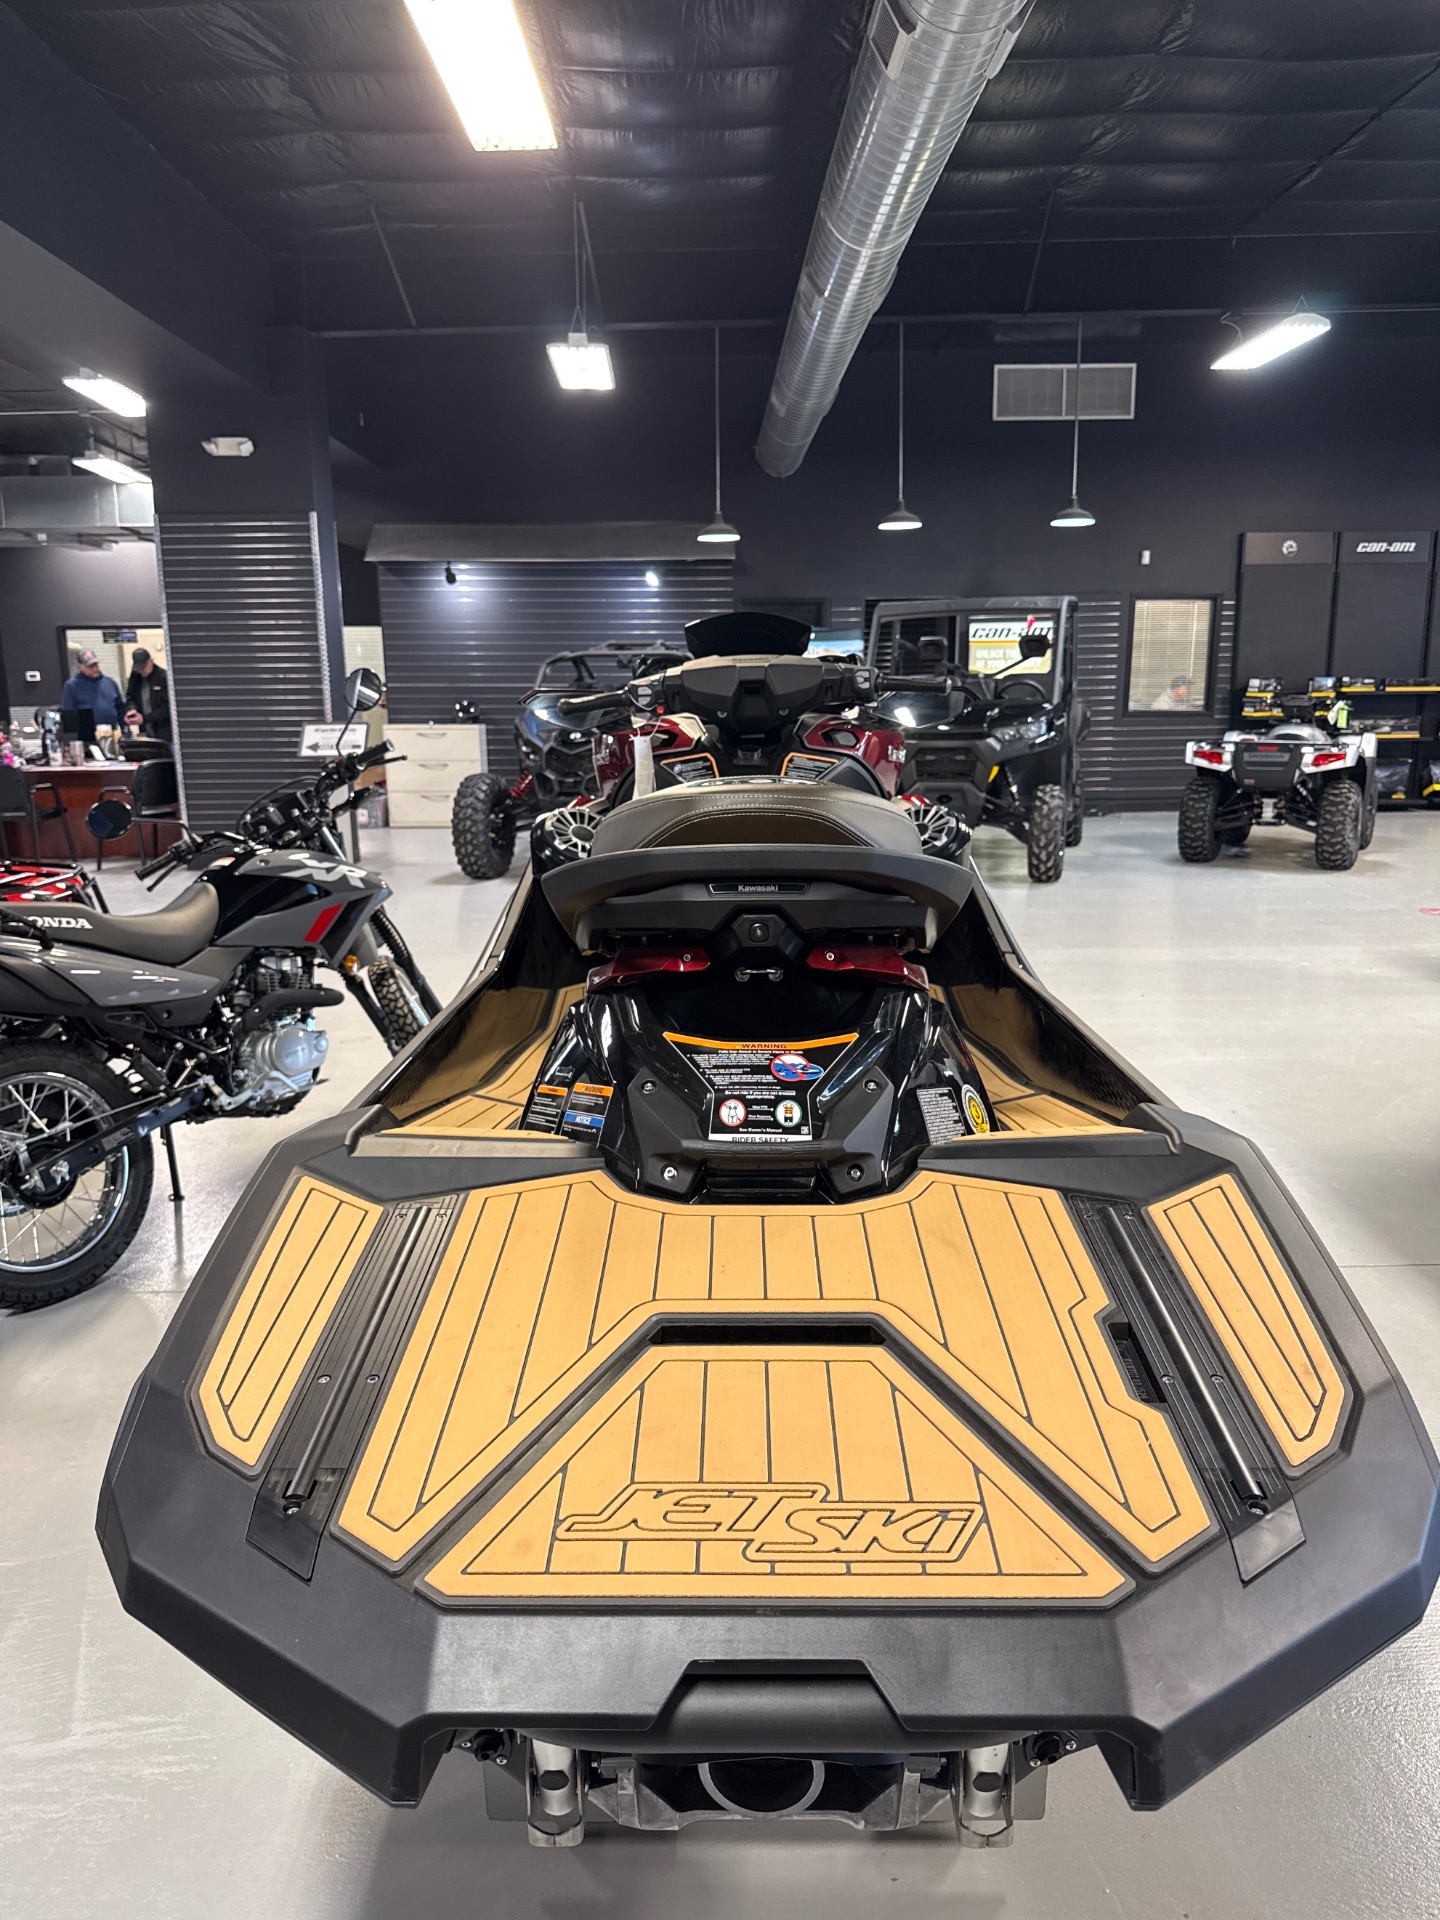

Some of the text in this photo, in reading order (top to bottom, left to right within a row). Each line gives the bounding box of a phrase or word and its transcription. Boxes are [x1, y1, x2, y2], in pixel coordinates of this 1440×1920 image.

[1356, 542, 1416, 552] can-am
[738, 884, 779, 892] Kawasaki
[8, 916, 94, 929] ONDA
